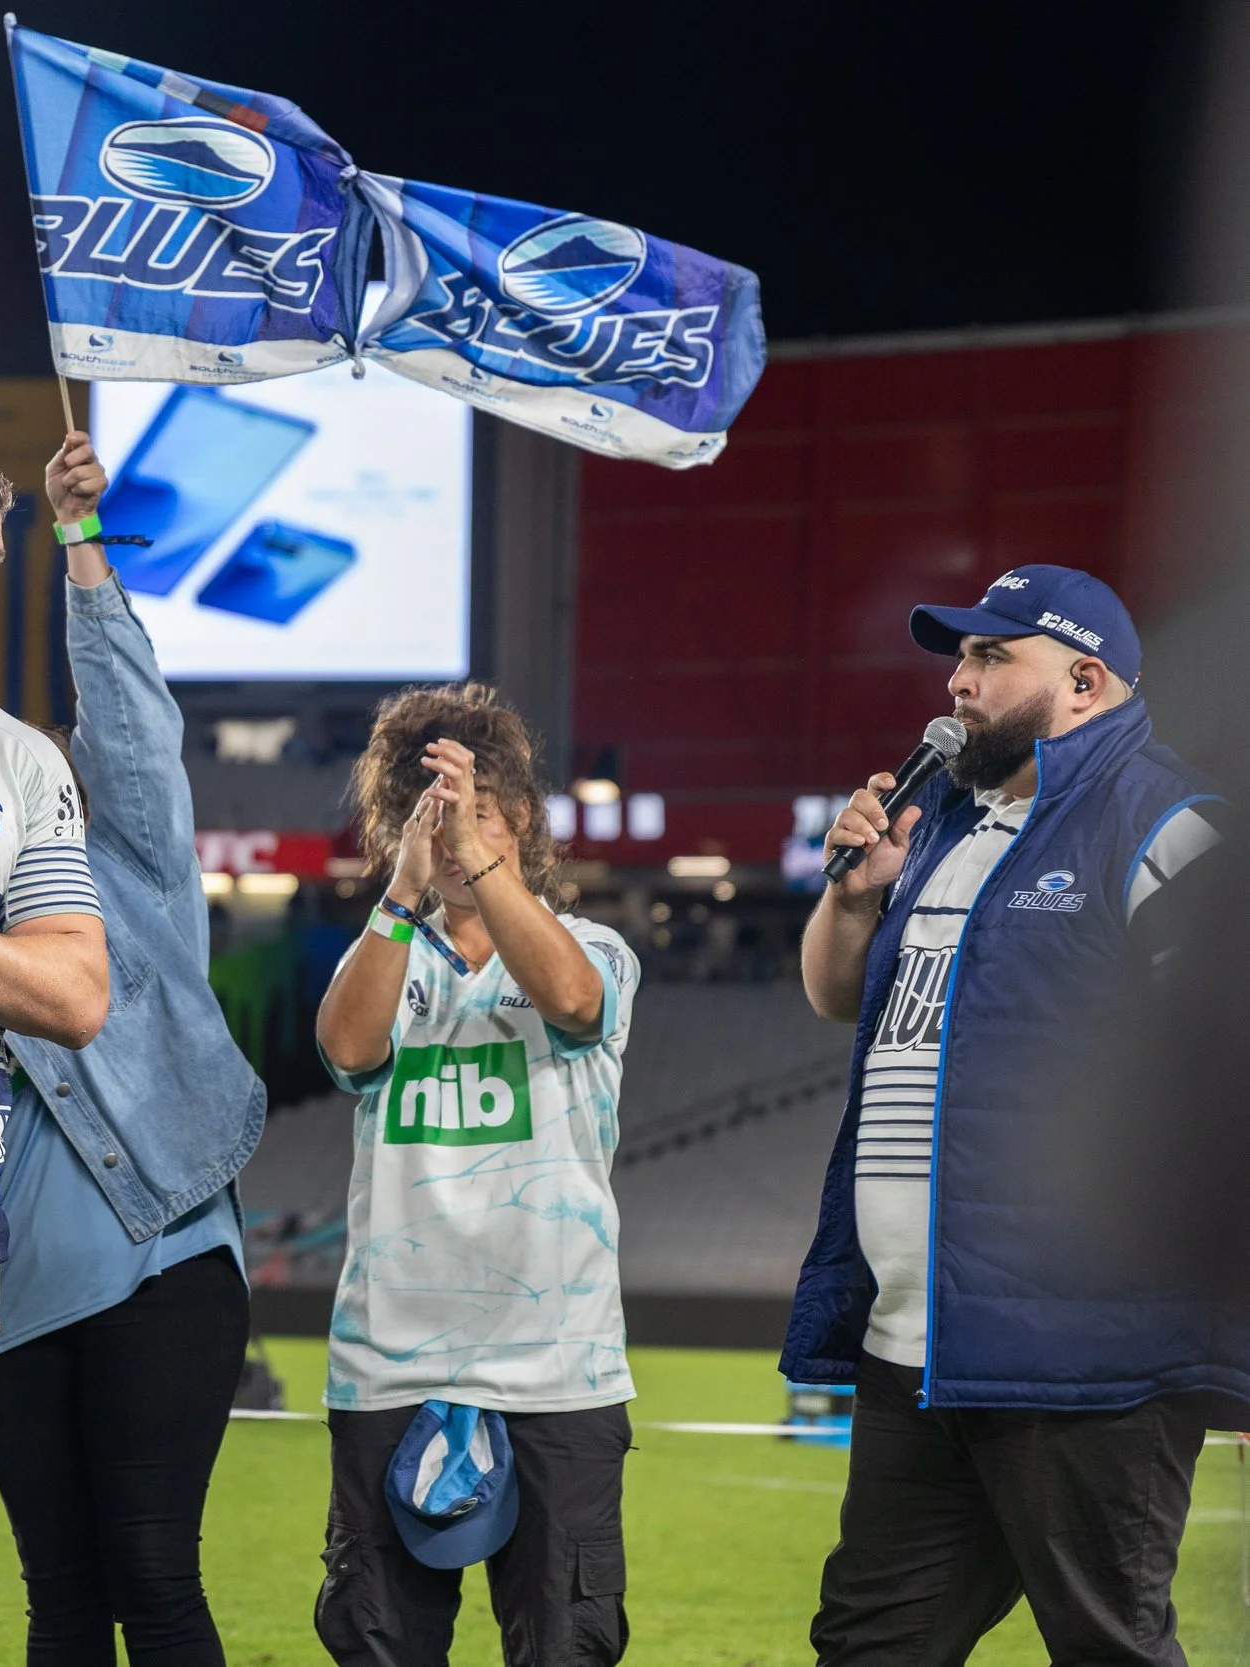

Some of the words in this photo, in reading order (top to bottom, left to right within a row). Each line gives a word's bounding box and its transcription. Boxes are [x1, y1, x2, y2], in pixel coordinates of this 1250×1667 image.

[31, 194, 338, 314] BLUES
[1058, 618, 1104, 646] BLUES
[195, 831, 279, 872] FC
[1007, 890, 1087, 912] BLUES
[499, 995, 535, 1009] BLU
[399, 1062, 515, 1131] nib
